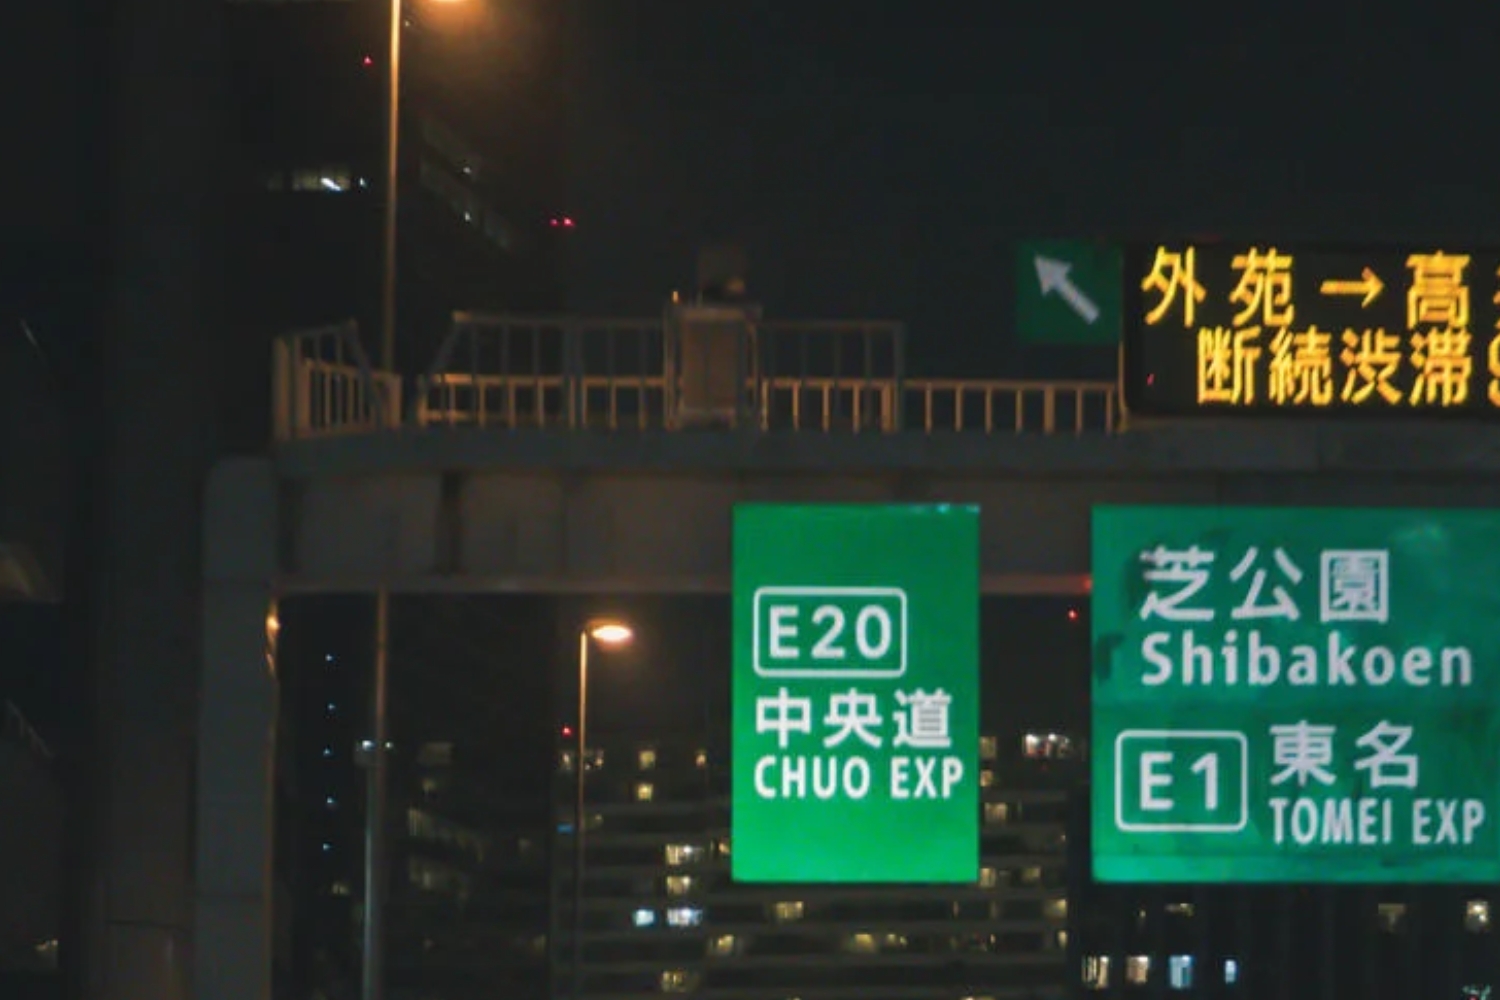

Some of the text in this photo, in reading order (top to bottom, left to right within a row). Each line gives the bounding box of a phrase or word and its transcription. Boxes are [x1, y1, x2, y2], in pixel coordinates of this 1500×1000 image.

[1139, 545, 1390, 623] 芝公園
[768, 605, 893, 659] E20
[1141, 630, 1472, 686] Shibakoen
[755, 687, 952, 750] 中央道
[754, 756, 965, 800] CHUO EXP
[1139, 752, 1219, 811] E1
[1268, 720, 1419, 790] 東名
[1268, 798, 1485, 845] TOMEI EXP
